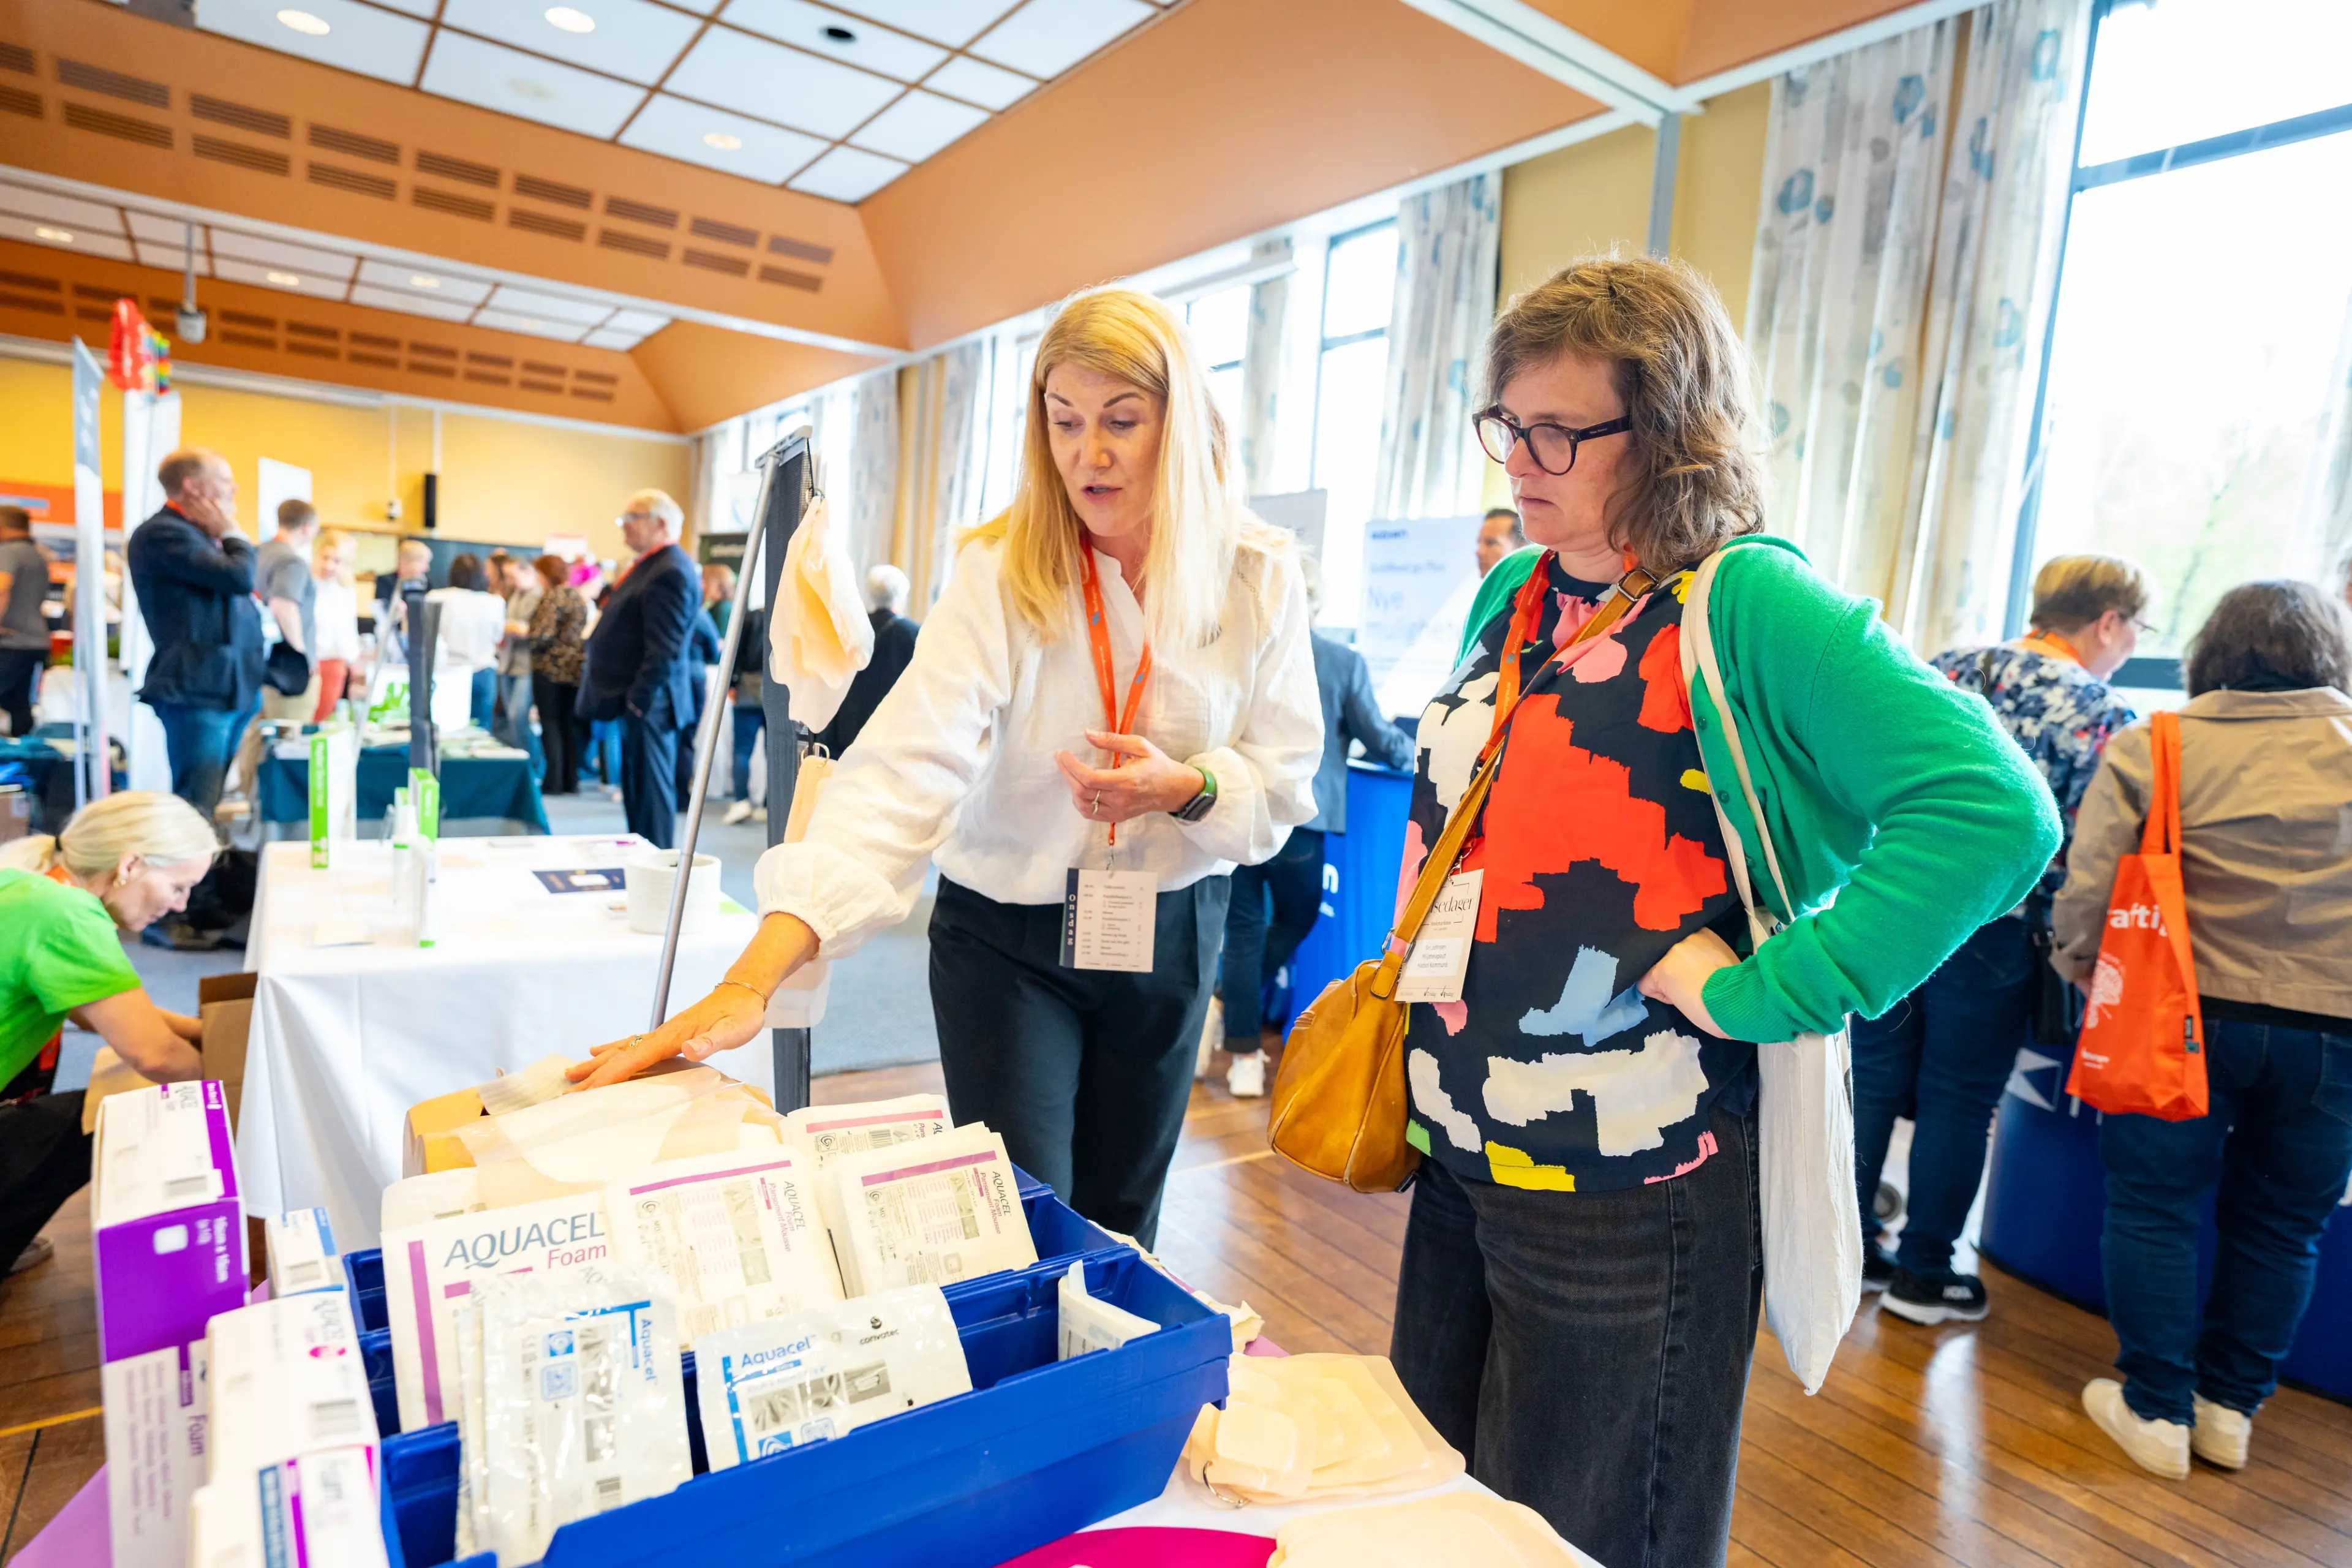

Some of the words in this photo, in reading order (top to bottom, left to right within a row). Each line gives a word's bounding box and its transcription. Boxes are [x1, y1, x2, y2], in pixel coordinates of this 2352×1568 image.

[1068, 894, 1076, 946] Onsdag
[1430, 896, 1474, 916] lsedager
[2107, 903, 2168, 937] afti
[783, 1181, 806, 1231] AQUACEL
[980, 1172, 994, 1208] Pansement
[991, 1209, 1001, 1234] Mousse
[992, 1171, 1011, 1216] AQUACEL
[993, 1199, 1002, 1216] Foam
[786, 1212, 795, 1231] Foam
[444, 1212, 605, 1270] AQUACEL
[548, 1245, 606, 1269] Foam
[641, 1318, 658, 1381] Aquacel
[742, 1335, 811, 1368] Aquacel
[860, 1329, 899, 1345] convatec
[188, 1414, 208, 1457] Foam
